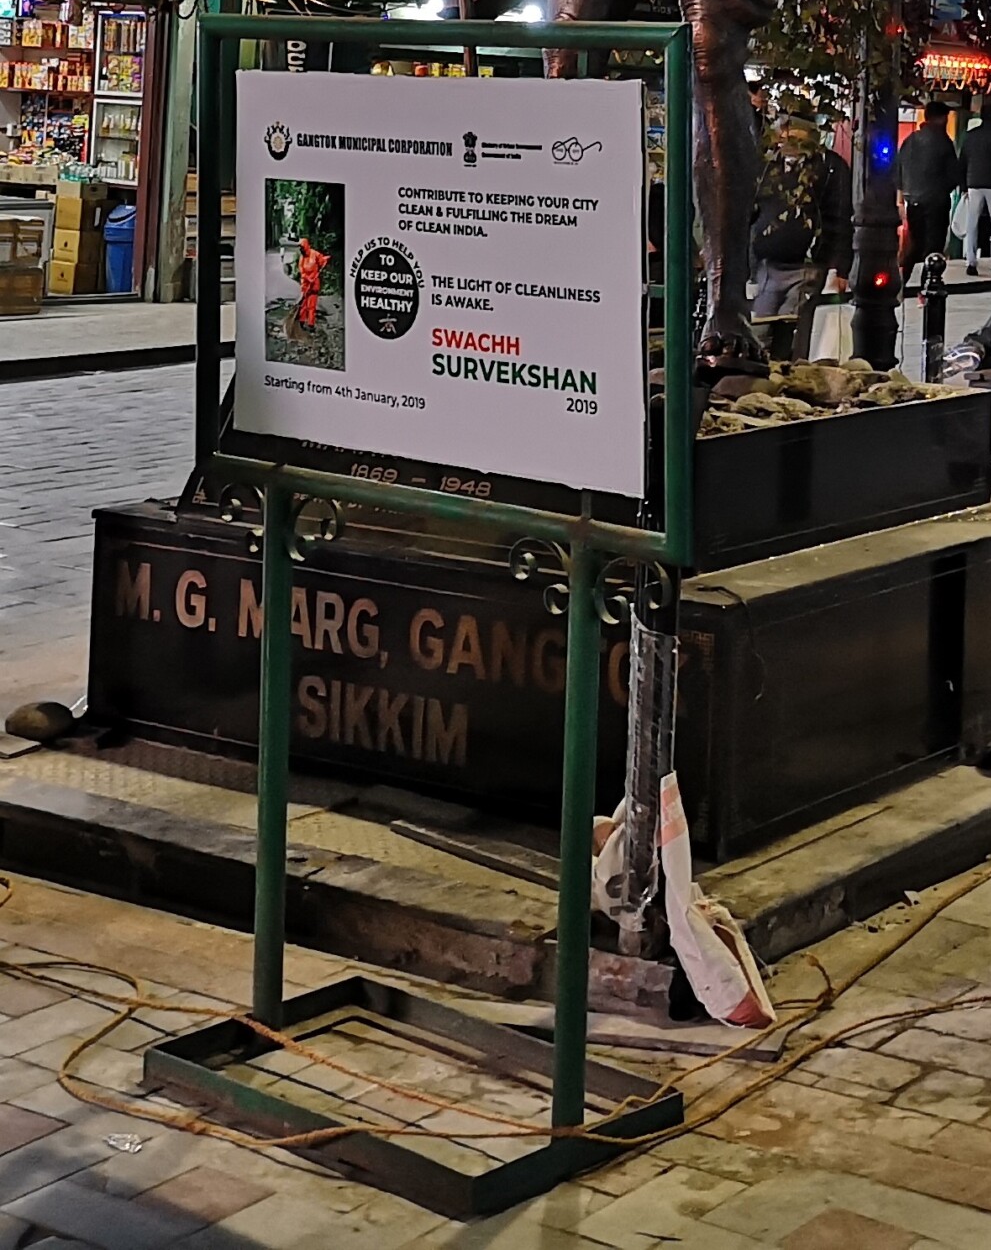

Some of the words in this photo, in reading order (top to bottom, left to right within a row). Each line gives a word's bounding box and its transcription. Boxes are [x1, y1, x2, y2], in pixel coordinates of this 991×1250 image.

[297, 133, 337, 150] GANGTOK
[339, 136, 387, 153] MUNICIPAL
[388, 138, 453, 157] CORPORATION
[398, 187, 466, 202] CONTRIBUTE
[468, 191, 483, 203] TO
[486, 193, 535, 207] KEEPING
[537, 196, 569, 210] YOUR
[572, 198, 598, 211] CITY
[398, 203, 433, 217] CLEAN
[436, 206, 443, 217] &
[446, 208, 508, 222] FULFILLING
[510, 211, 532, 224] THE
[536, 213, 577, 227] DREAM
[398, 219, 413, 231] OF
[416, 221, 450, 234] CLEAN
[453, 224, 488, 238] INDIA.
[350, 249, 364, 278] HELP
[364, 239, 376, 251] US
[377, 237, 390, 246] TO
[392, 239, 414, 260] HELP
[413, 261, 425, 288] YOU
[379, 254, 395, 266] TO
[360, 269, 388, 281] KEEP
[389, 272, 413, 285] OUR
[431, 275, 454, 289] THE
[457, 278, 492, 292] LIGHT
[495, 281, 512, 294] OF
[515, 283, 601, 303] CLEANLINESS
[360, 284, 414, 298] ENVIRONMENT
[431, 294, 442, 306] IS
[445, 295, 494, 311] AWAKE.
[360, 296, 413, 313] HEALTHY
[432, 328, 520, 356] SWACHH
[432, 353, 597, 395] SURVEKSHAN
[264, 375, 305, 394] Starting
[307, 380, 332, 396] from
[334, 385, 353, 399] 4th
[355, 388, 400, 408] January,
[402, 395, 426, 410] 2019
[566, 398, 598, 415] 2019
[350, 462, 398, 484] 1869
[439, 475, 492, 497] 1948
[115, 560, 160, 622] M.
[175, 570, 216, 632] G.
[298, 675, 467, 767] SIKKIM
